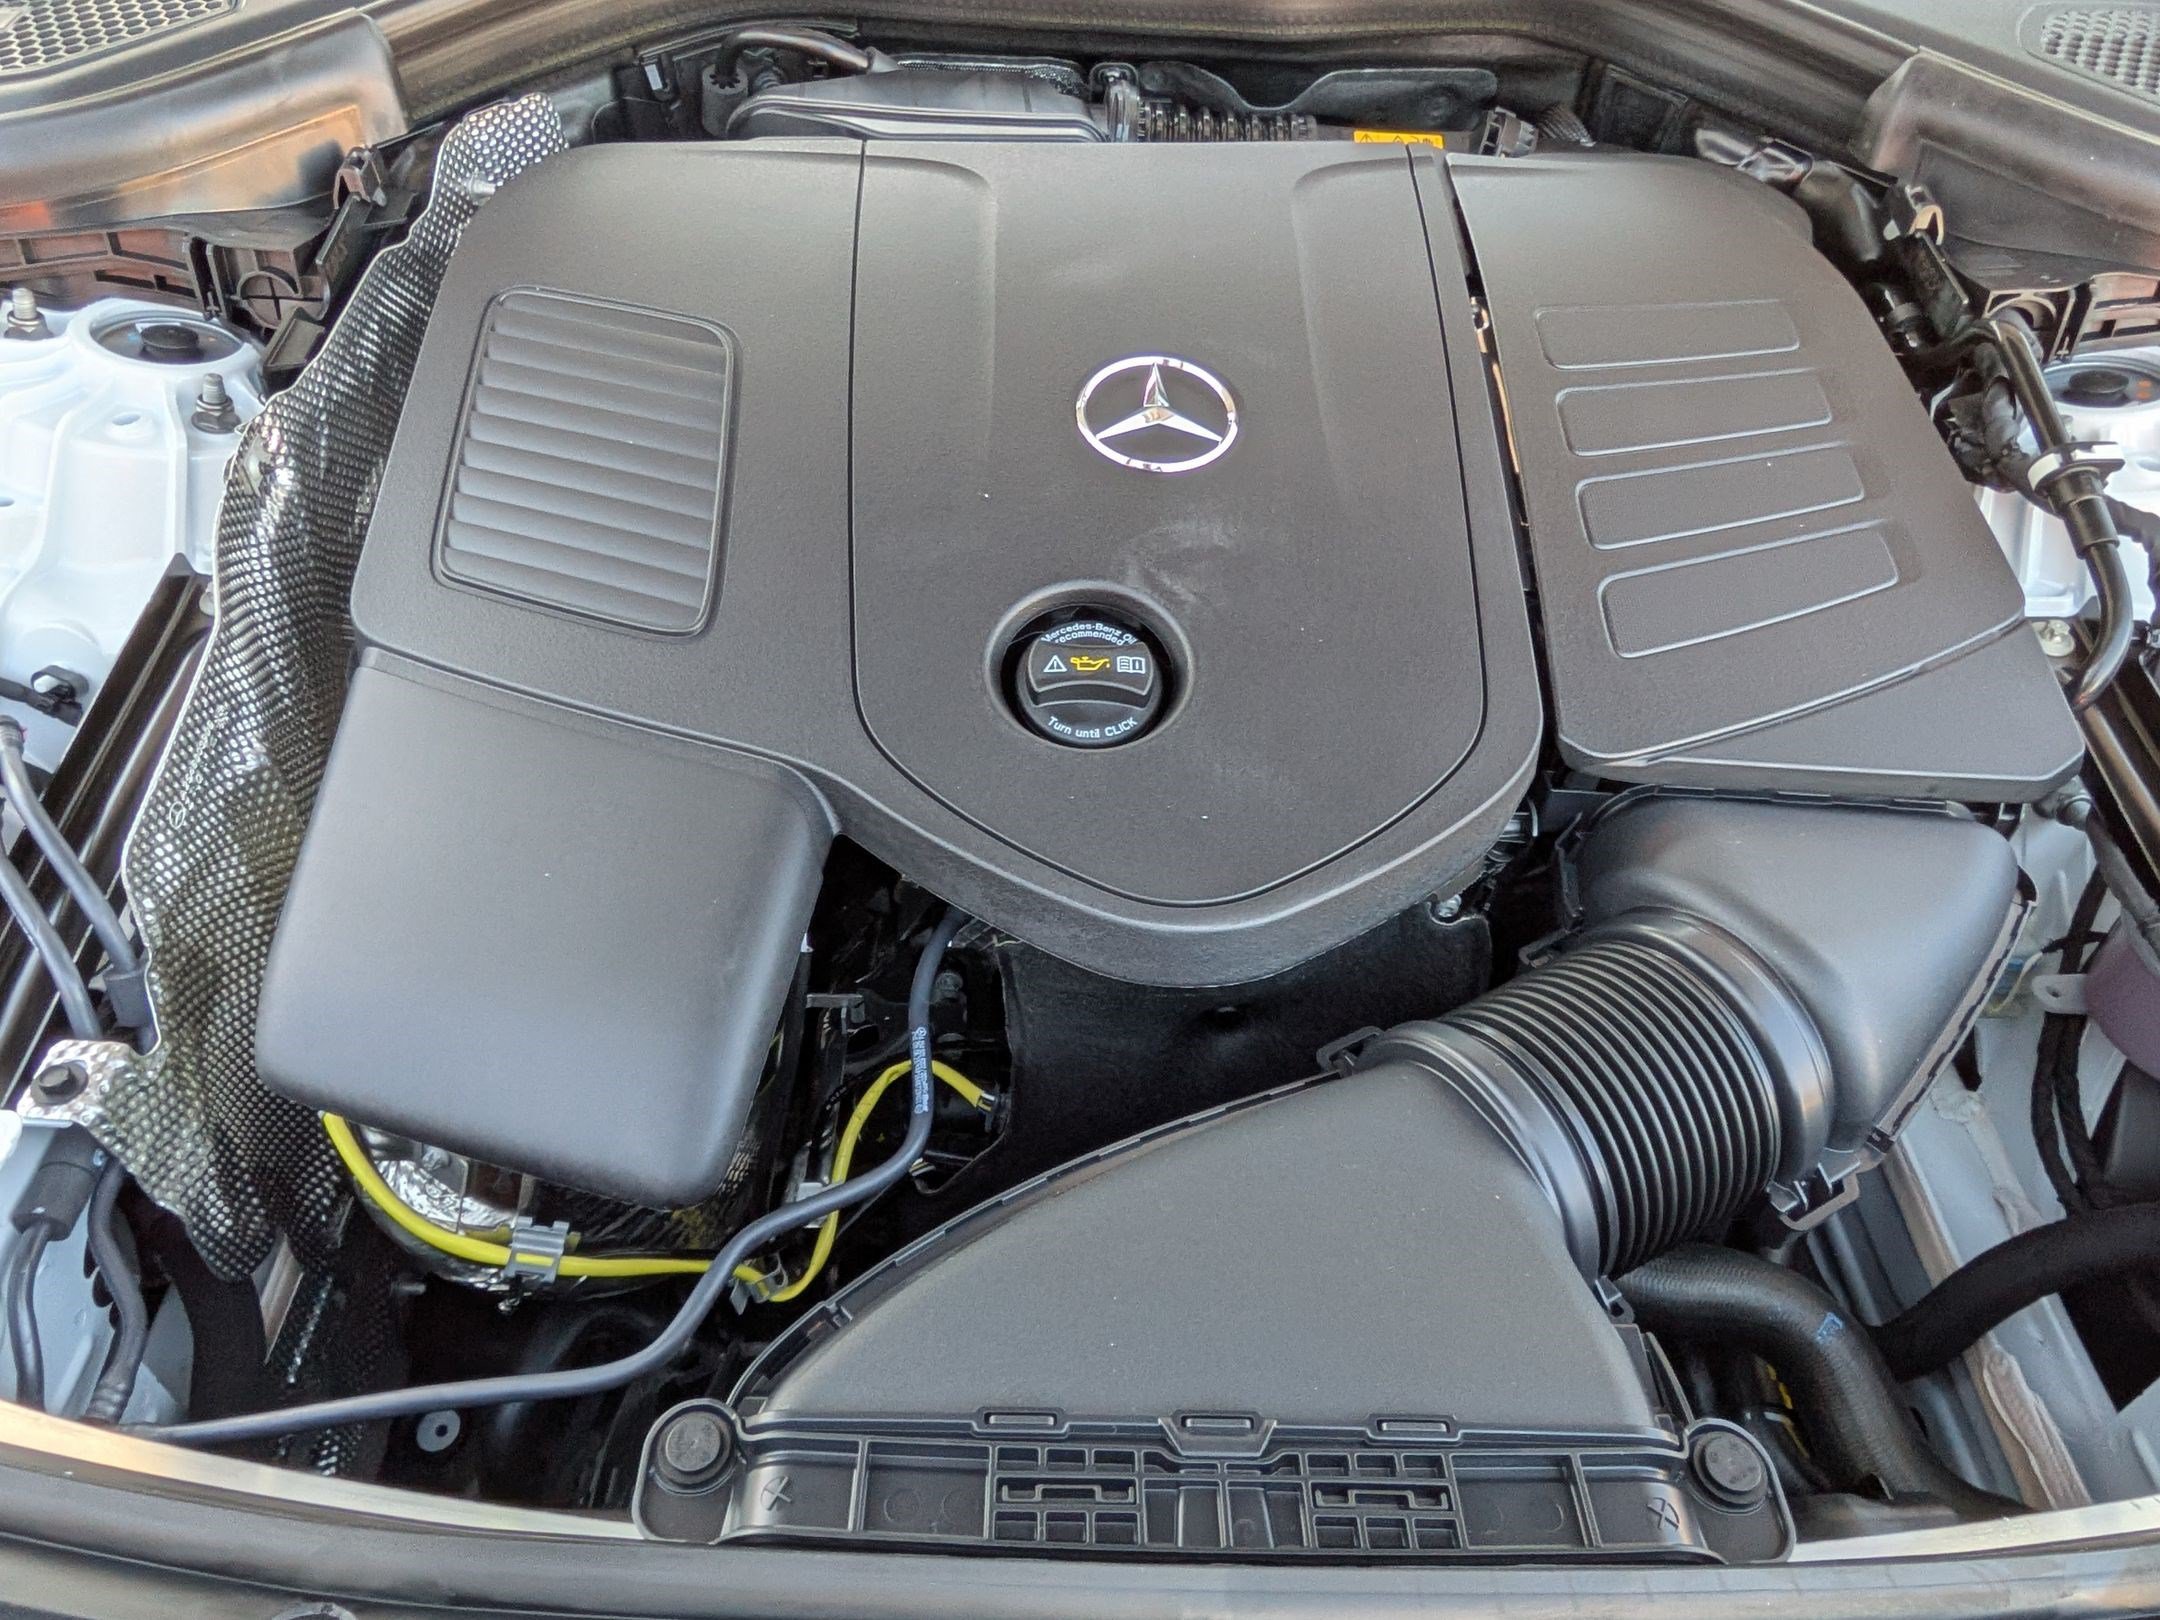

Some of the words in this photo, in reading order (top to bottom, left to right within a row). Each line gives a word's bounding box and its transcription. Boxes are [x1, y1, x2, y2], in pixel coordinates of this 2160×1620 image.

[1040, 622, 1122, 643] Mercedes-Benz
[1122, 633, 1138, 645] Oil
[1054, 631, 1126, 646] recommended
[1047, 716, 1072, 735] Turn
[1075, 728, 1100, 738] until
[1104, 716, 1138, 737] CLICK
